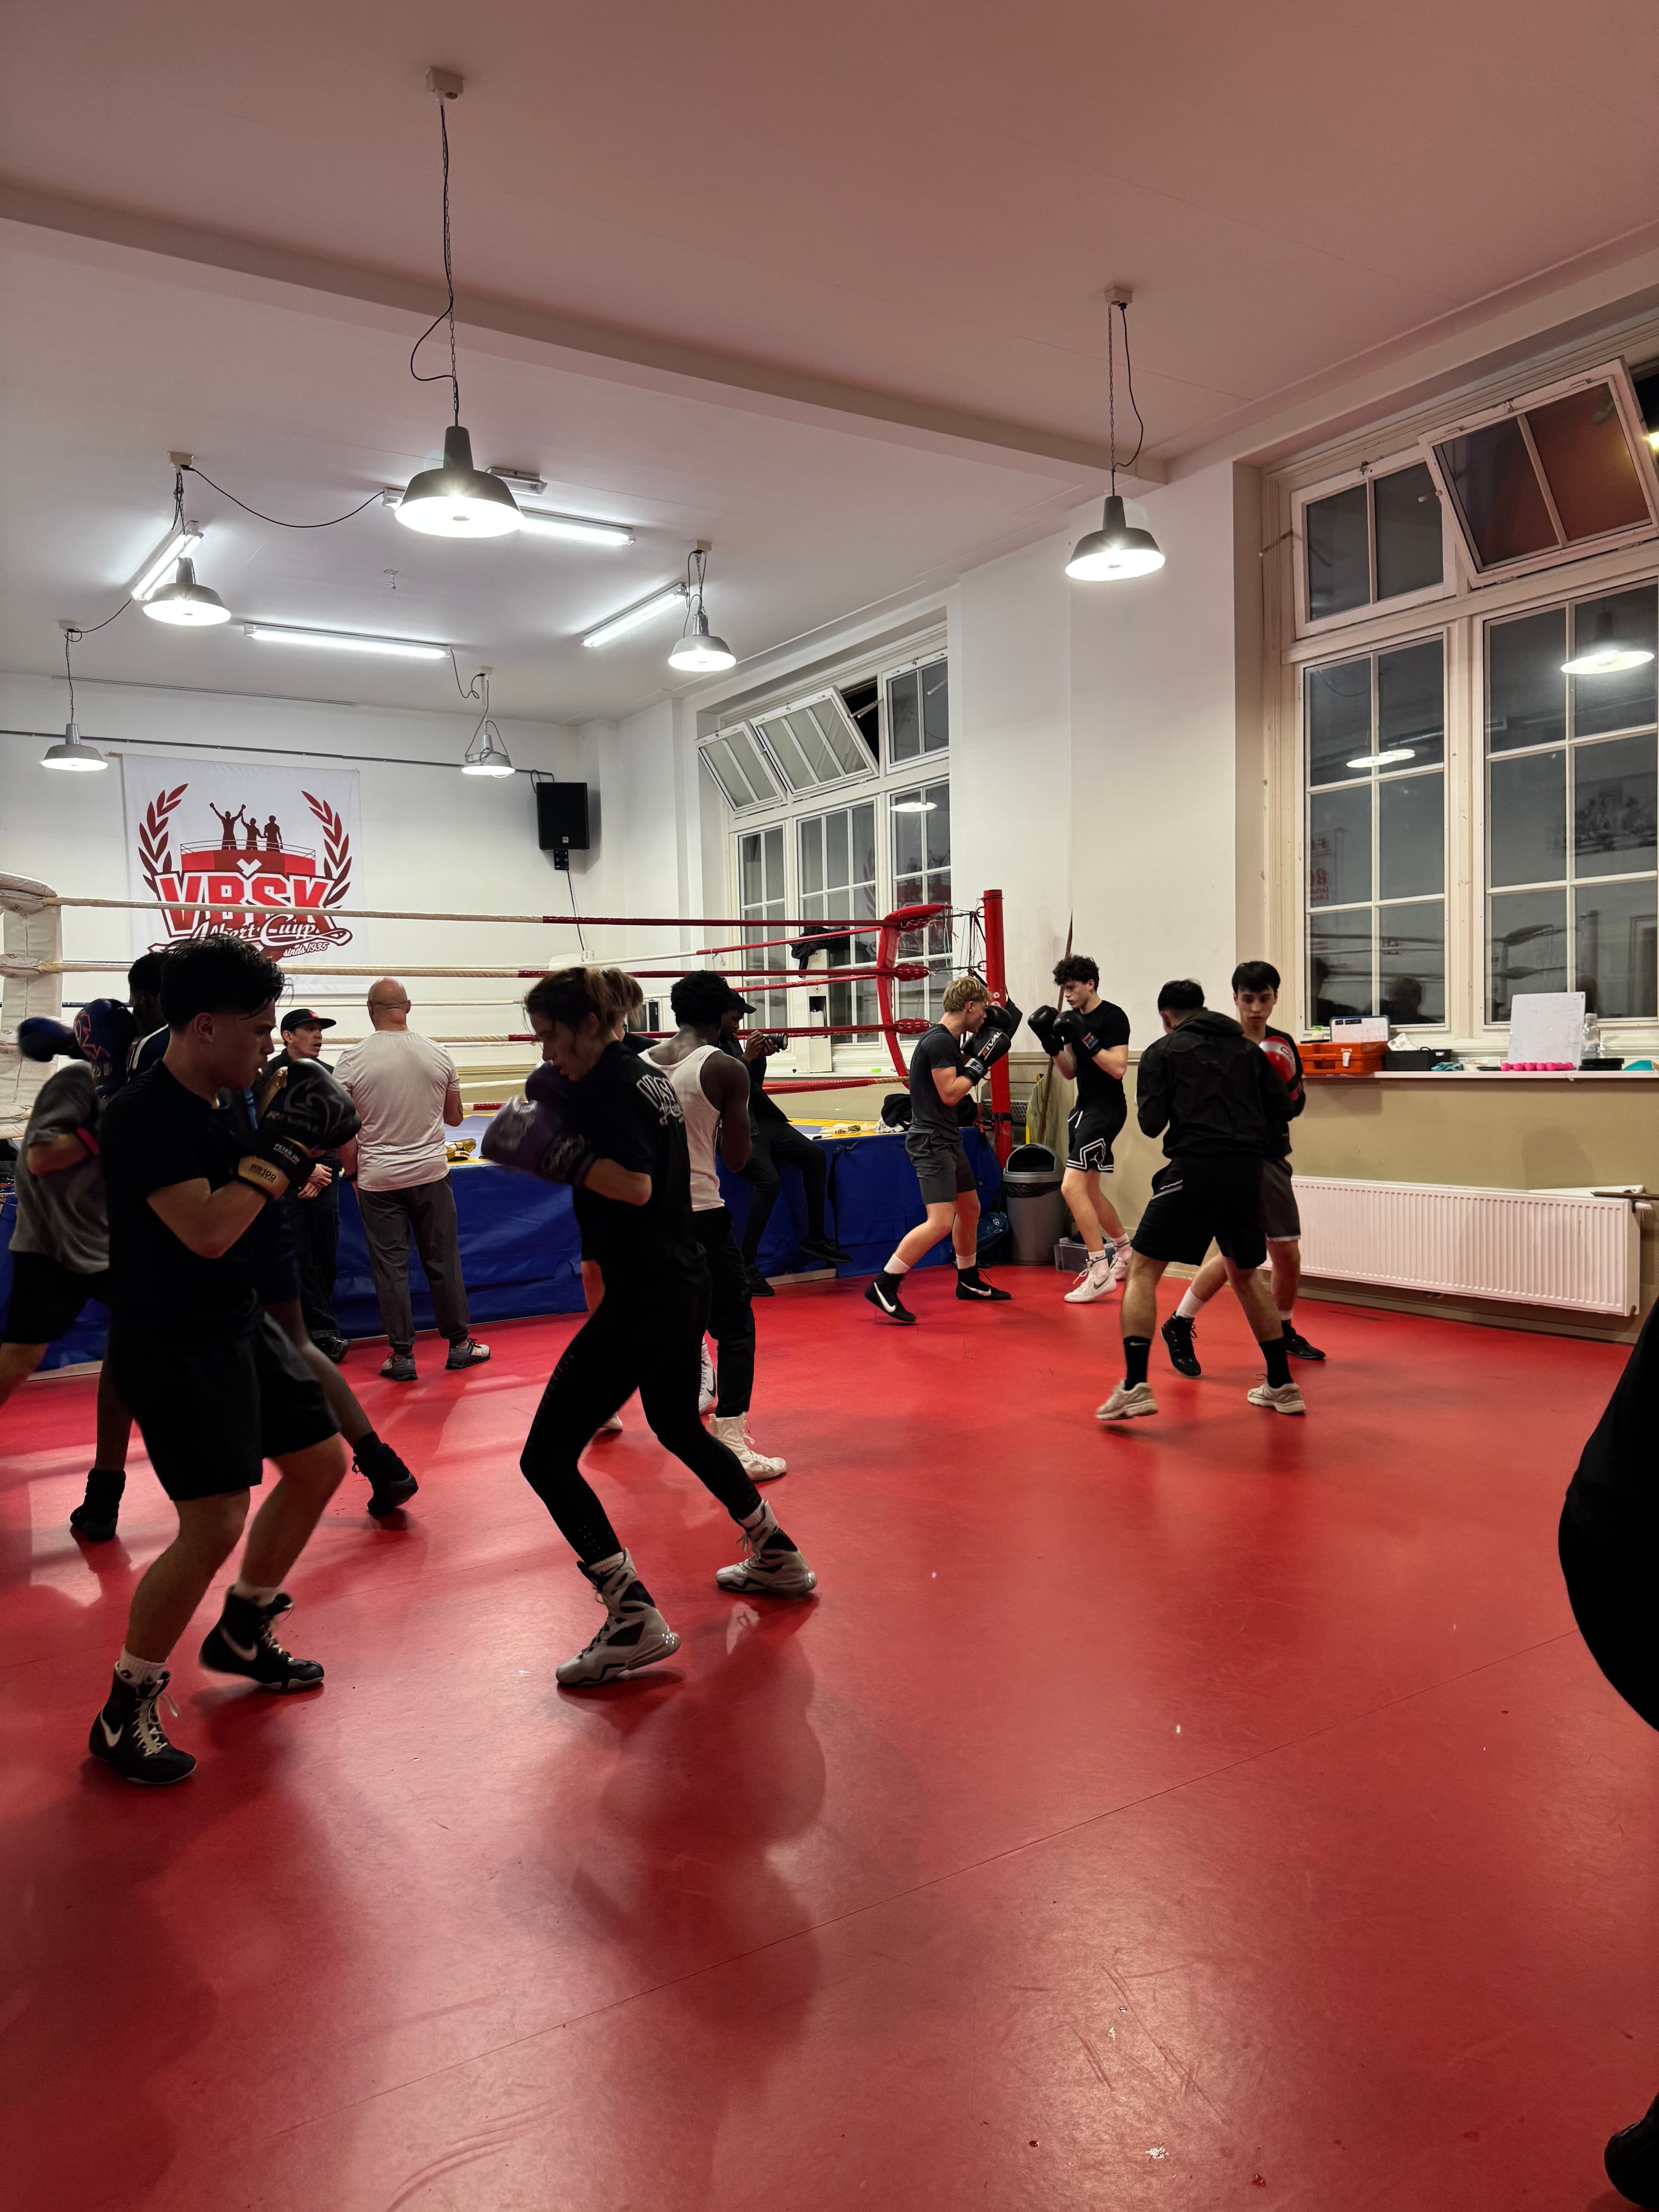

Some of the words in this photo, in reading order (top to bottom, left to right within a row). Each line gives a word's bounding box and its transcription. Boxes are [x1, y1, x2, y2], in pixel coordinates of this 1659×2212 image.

[155, 872, 335, 934] VBSK
[192, 921, 256, 941] Albert
[283, 945, 306, 957] sinds
[307, 942, 329, 953] 1935
[981, 1032, 1002, 1056] RIVAL
